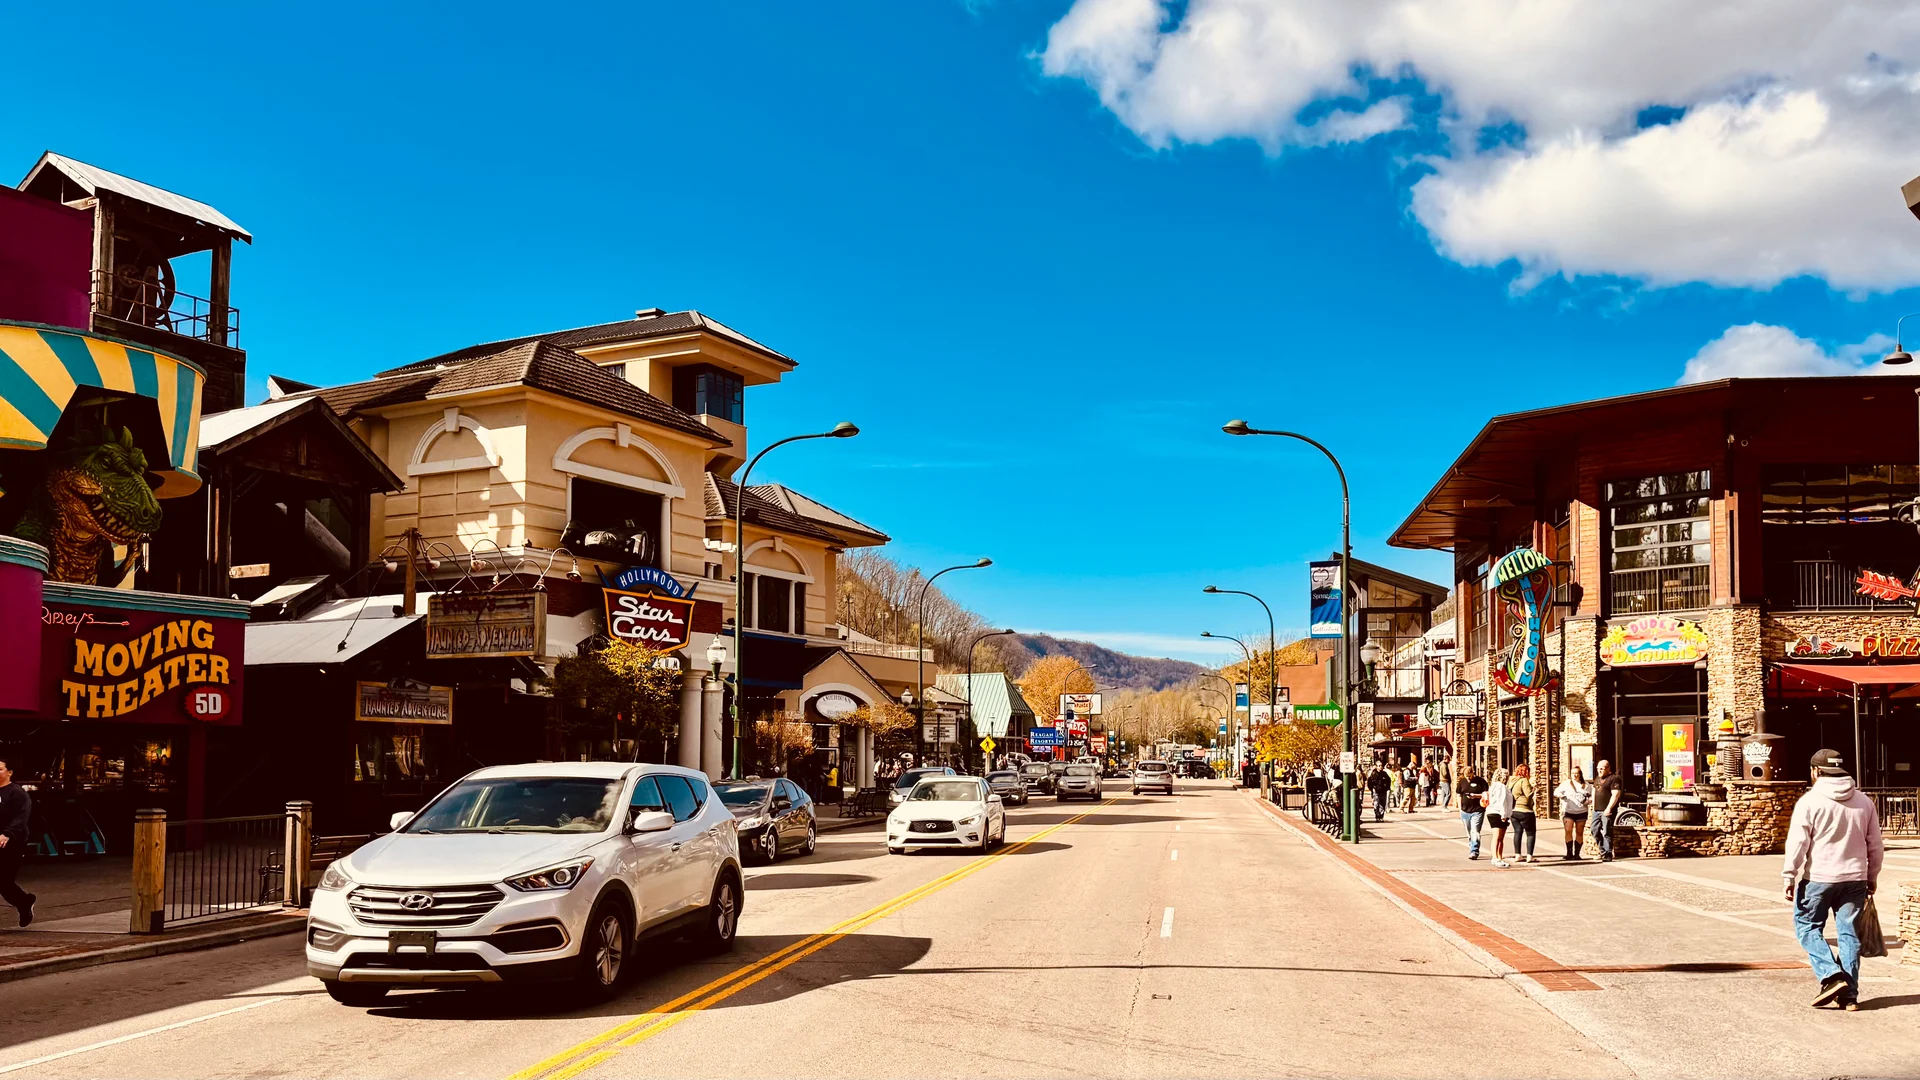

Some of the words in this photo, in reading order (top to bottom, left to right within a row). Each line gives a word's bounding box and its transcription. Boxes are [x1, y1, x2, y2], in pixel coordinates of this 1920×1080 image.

[1497, 550, 1547, 583] MELLOW
[620, 569, 680, 595] HOLLYWOOD
[612, 596, 684, 624] Star
[612, 616, 681, 643] Cars
[1519, 575, 1541, 688] MUSHROOM
[73, 620, 215, 677] MOVING
[1612, 645, 1698, 663] DAIQUIRIS
[62, 653, 230, 719] THEATER
[1504, 678, 1547, 696] PIZZA
[195, 693, 222, 714] 5D
[365, 697, 399, 715] HAUNTED
[401, 701, 447, 718] ADVENTURE
[1296, 709, 1340, 720] PARKING
